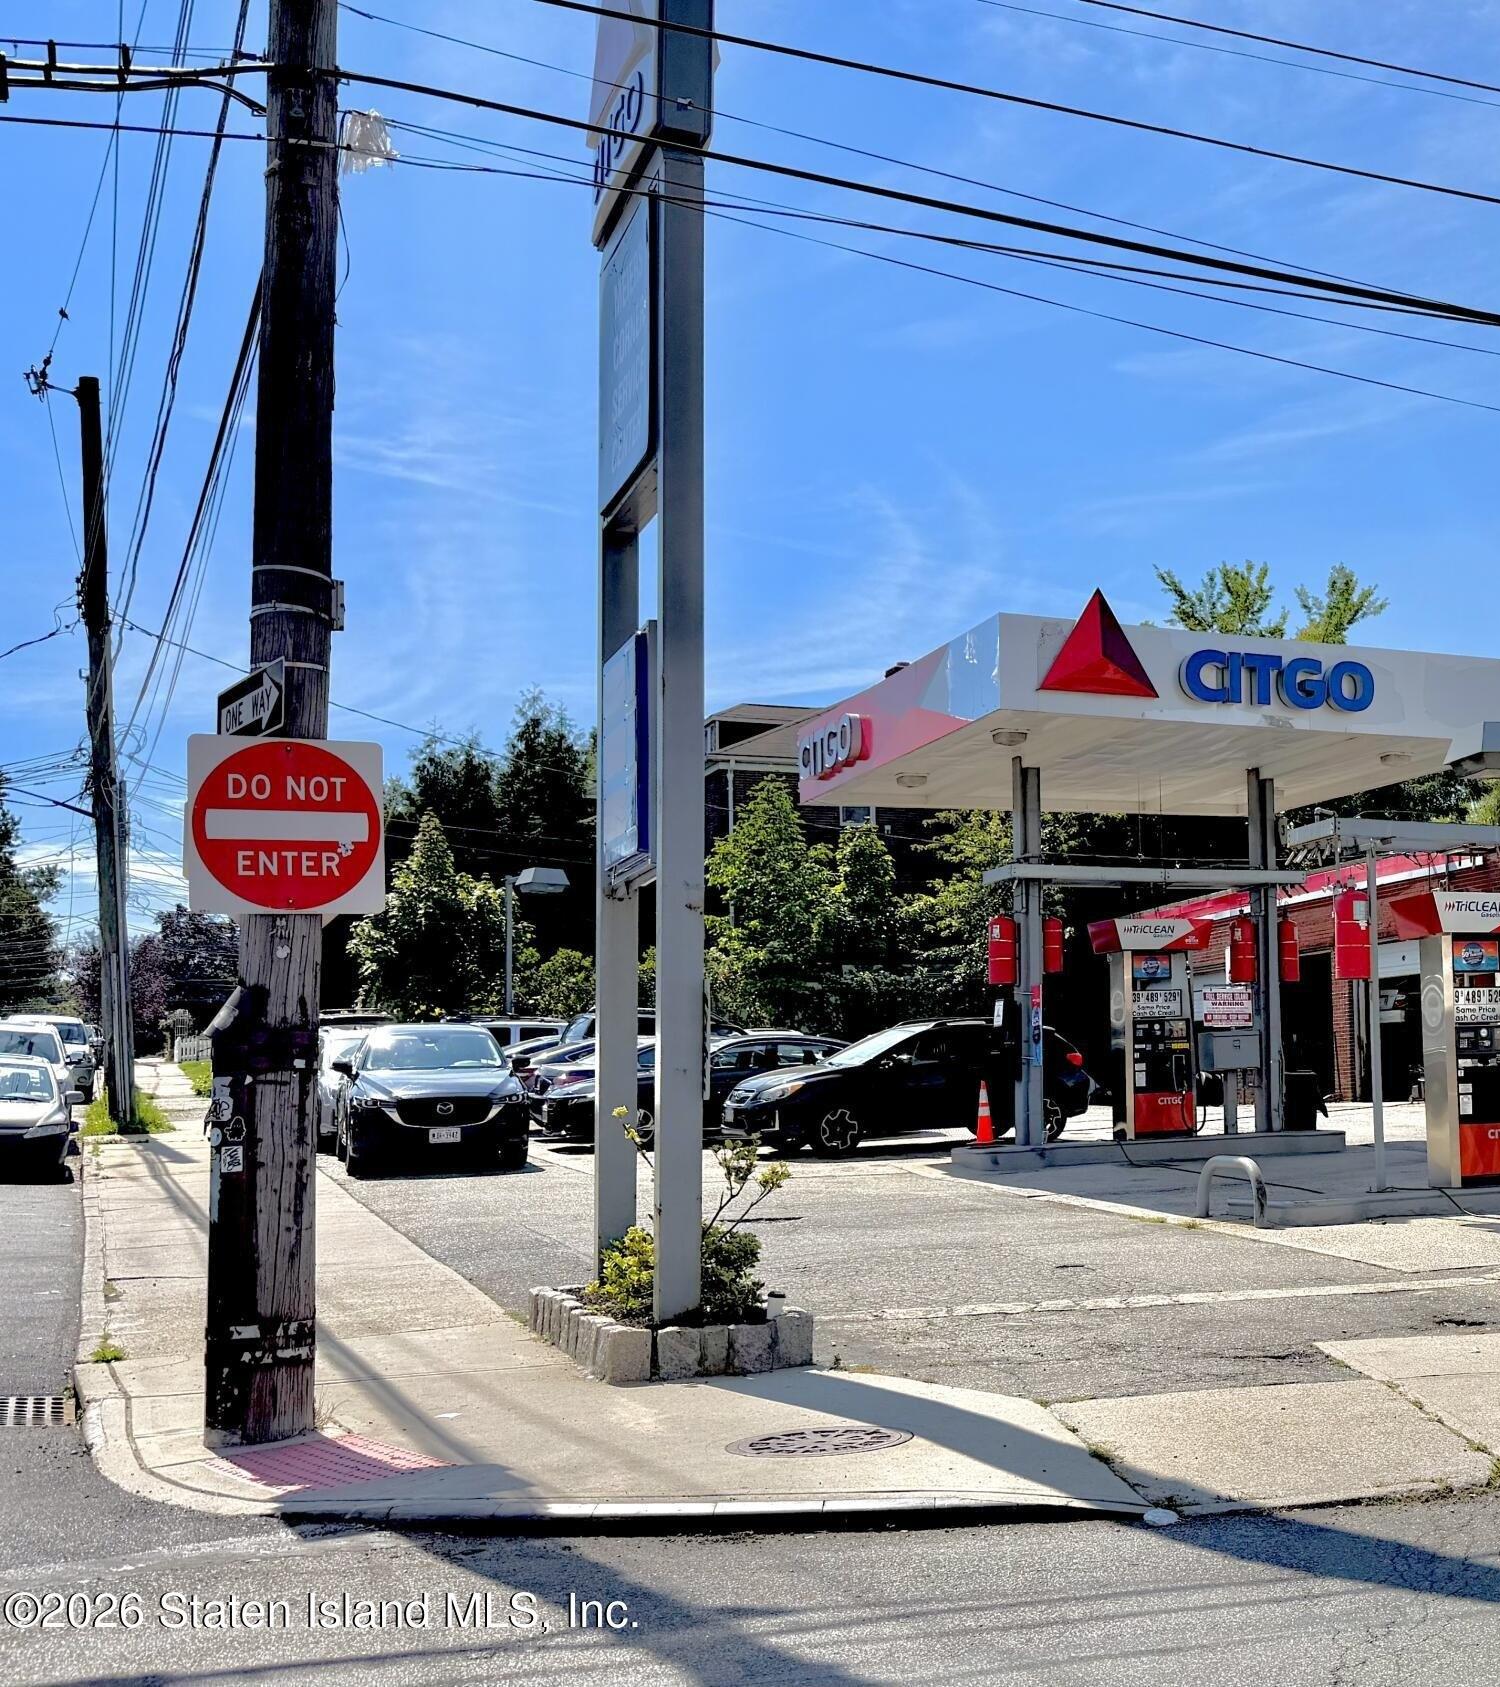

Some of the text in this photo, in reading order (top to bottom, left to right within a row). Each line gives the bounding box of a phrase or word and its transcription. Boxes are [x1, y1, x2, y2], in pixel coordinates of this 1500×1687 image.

[1181, 649, 1374, 712] CITGO
[225, 686, 273, 733] ONE WAY
[799, 713, 857, 780] CITGO
[227, 773, 347, 801] DO NOT
[237, 850, 341, 877] ENTER
